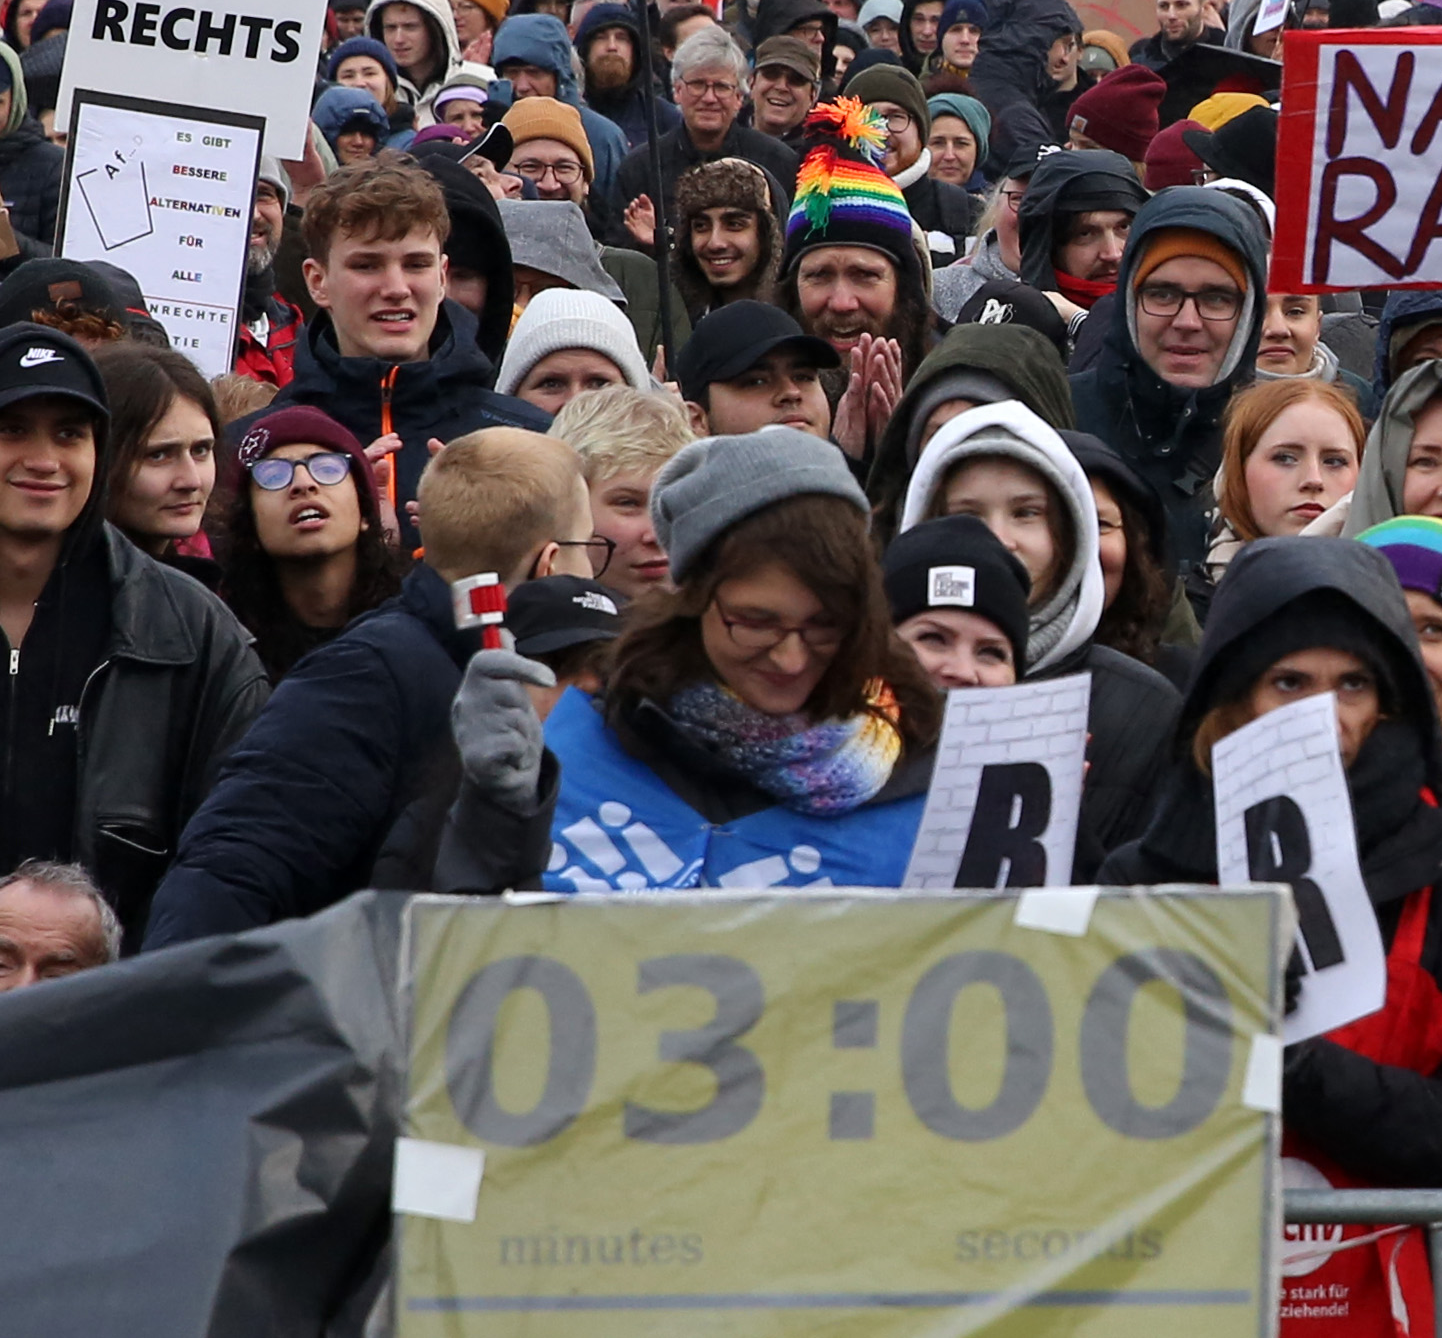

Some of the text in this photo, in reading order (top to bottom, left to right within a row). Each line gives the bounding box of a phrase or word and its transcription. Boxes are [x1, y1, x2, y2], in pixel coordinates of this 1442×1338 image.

[176, 132, 232, 149] ES GIBT
[172, 165, 227, 181] BESSERE
[149, 196, 241, 219] ALTERNATIVEN
[178, 234, 204, 248] FÜR
[172, 270, 202, 282] ALLE
[149, 304, 228, 324] NRECHTE
[27, 347, 56, 359] NIKE
[444, 948, 1235, 1149] 03:00
[498, 1226, 704, 1265] minutes
[1290, 1284, 1327, 1300] stark
[1328, 1283, 1350, 1298] für
[1281, 1302, 1349, 1319] ziehende!
